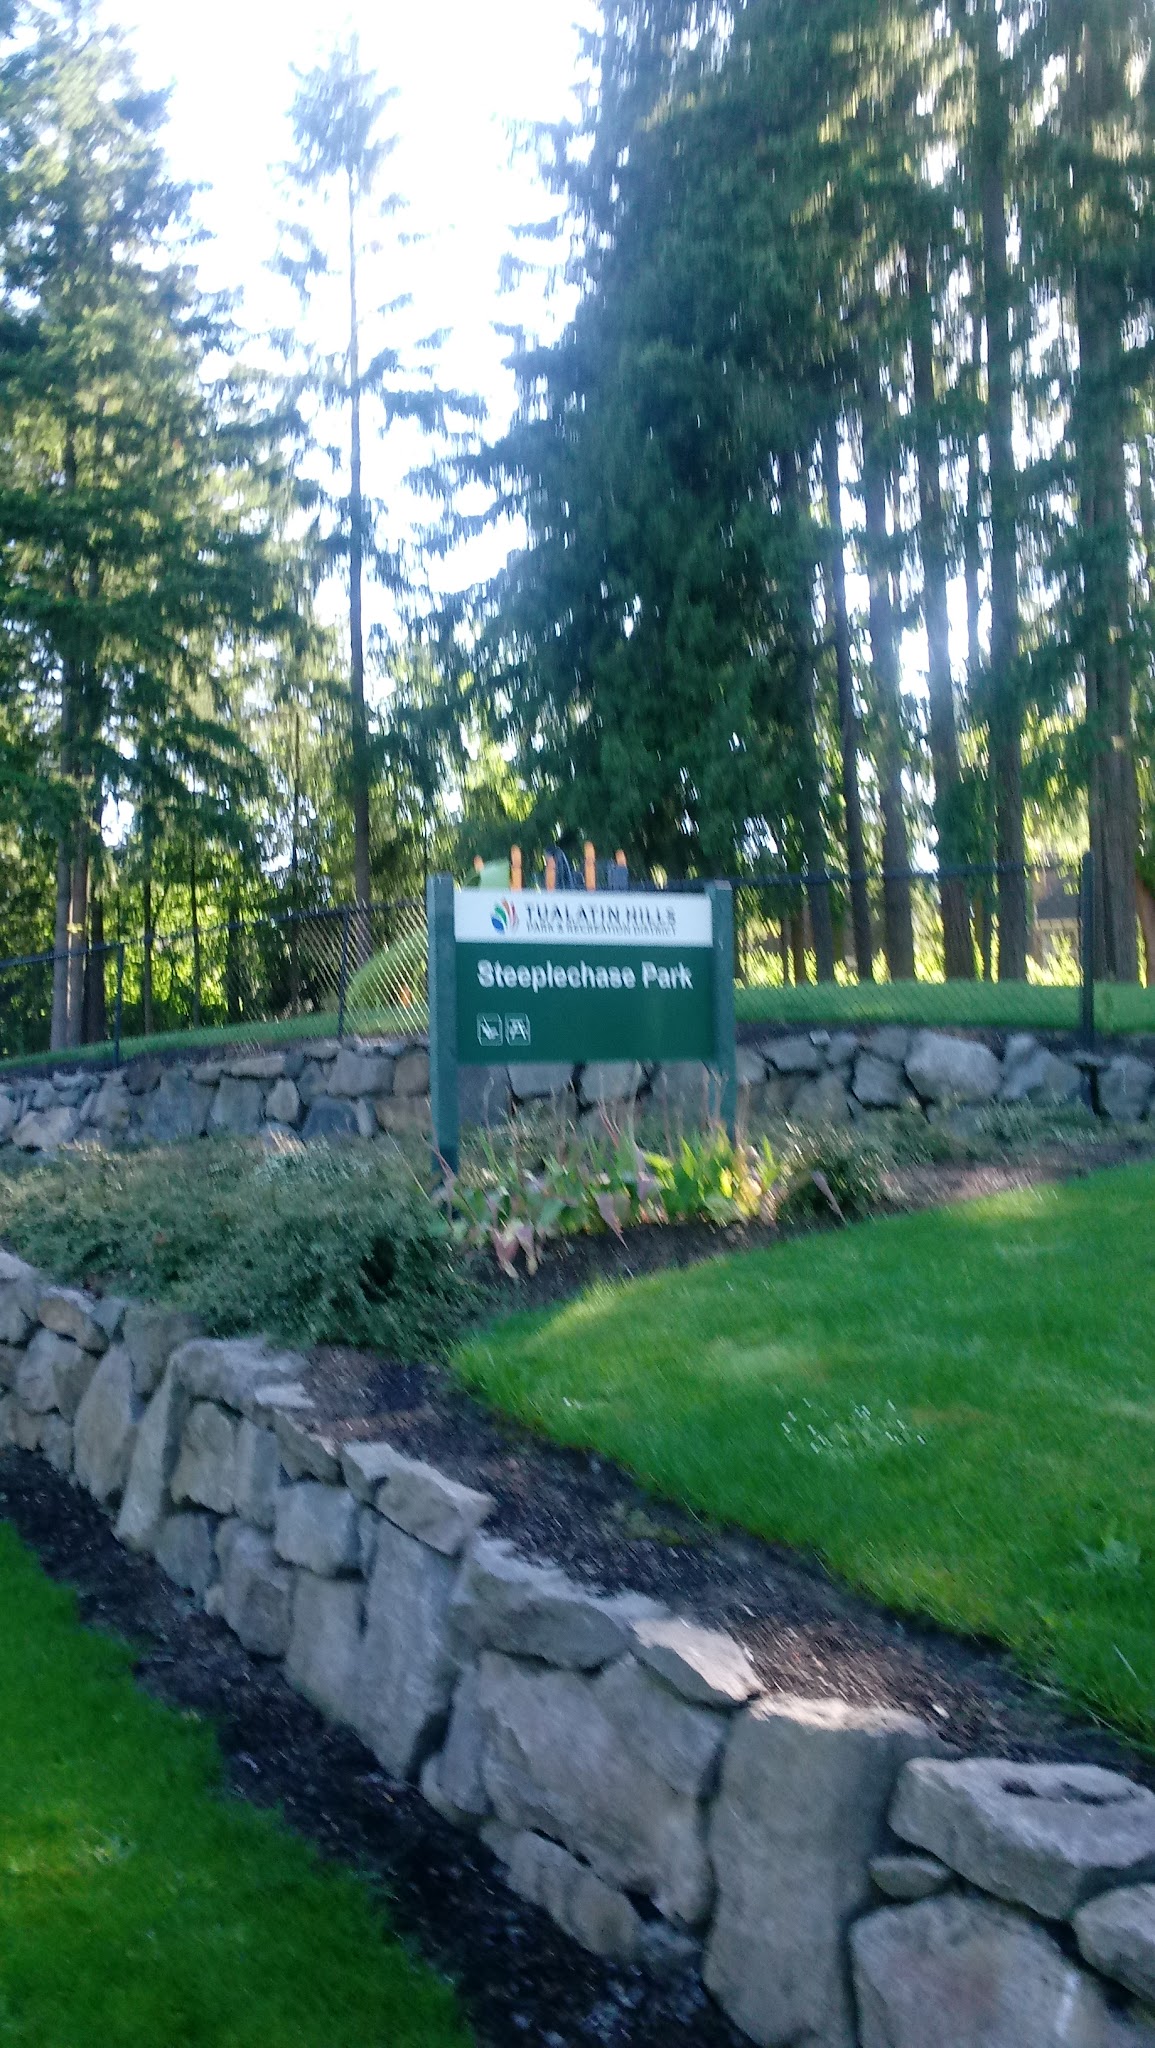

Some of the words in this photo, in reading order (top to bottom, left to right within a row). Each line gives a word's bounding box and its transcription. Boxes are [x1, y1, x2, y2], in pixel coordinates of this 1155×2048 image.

[525, 902, 620, 924] TUALATIN
[624, 904, 677, 925] HILLS
[477, 959, 636, 993] Steeplechase
[641, 961, 694, 990] Park
